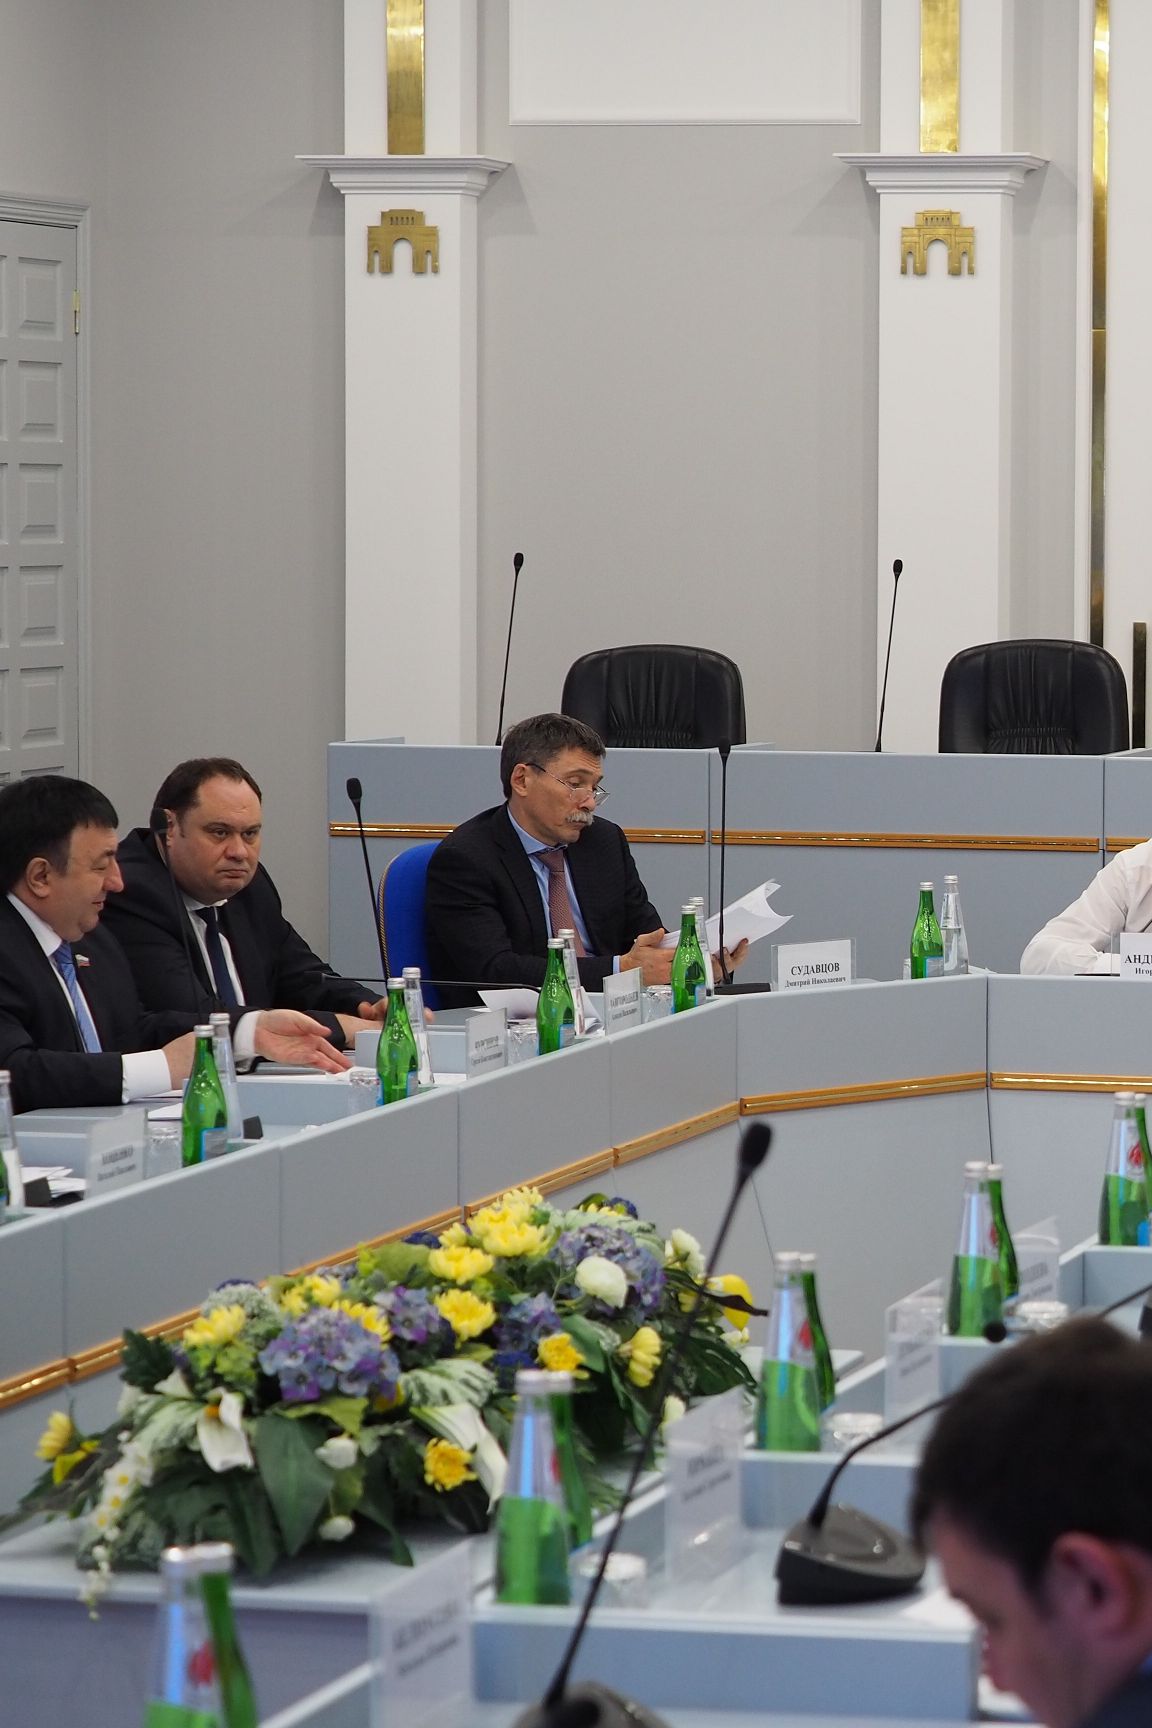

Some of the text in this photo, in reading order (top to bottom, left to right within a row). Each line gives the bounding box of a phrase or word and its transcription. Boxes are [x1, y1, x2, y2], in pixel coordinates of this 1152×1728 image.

[790, 962, 840, 976] СУДАВЦОВ
[785, 976, 847, 988] Дмитрий Николаевич
